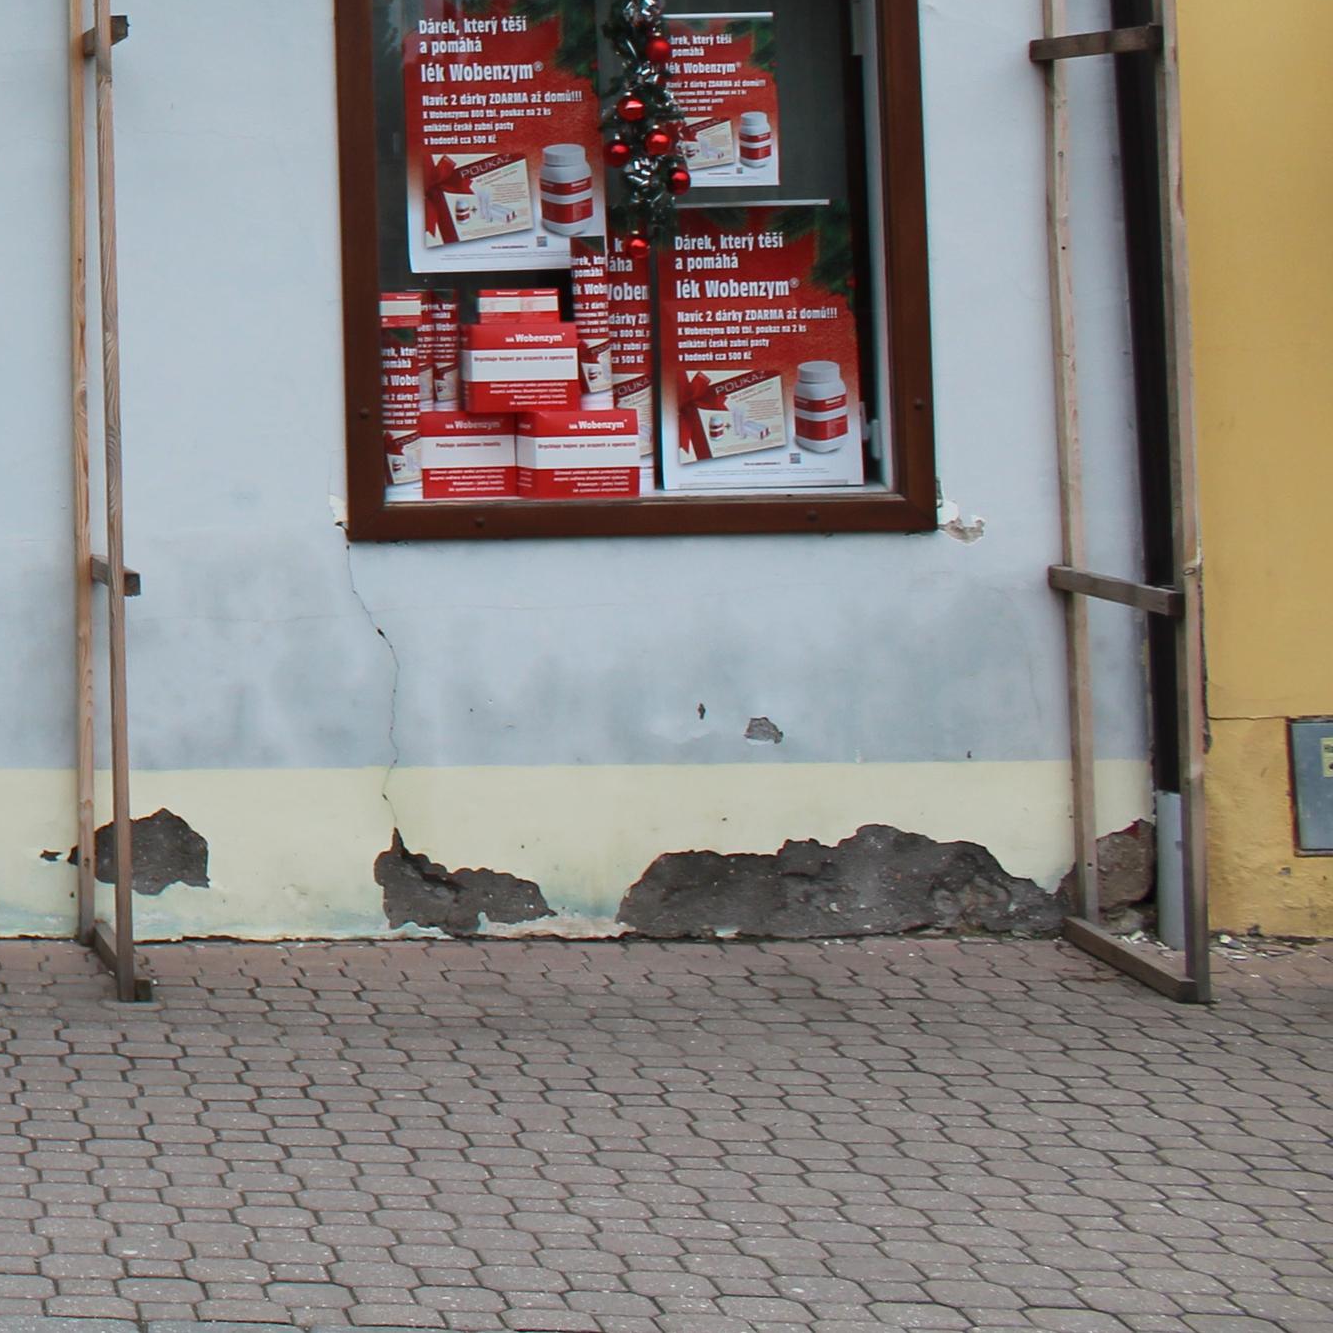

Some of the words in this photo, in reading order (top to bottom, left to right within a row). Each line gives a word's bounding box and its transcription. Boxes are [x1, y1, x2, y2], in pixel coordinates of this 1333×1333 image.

[419, 18, 459, 35] Dárek,
[464, 17, 498, 35] který
[501, 16, 527, 32] těší
[419, 42, 427, 54] a
[432, 37, 482, 56] pomáhá
[670, 35, 690, 45] árek,
[693, 35, 714, 46] který
[421, 62, 445, 82] lék
[422, 94, 448, 106] Navíc
[451, 95, 457, 105] 2
[460, 93, 486, 106] dárky
[489, 92, 528, 103] ZDARMA
[531, 92, 541, 102] až
[460, 155, 512, 178] POUKAZ
[675, 234, 715, 251] Dárek,
[720, 233, 754, 251] který
[758, 232, 783, 248] těší
[675, 258, 683, 270] a
[687, 253, 738, 272] pomáhá
[677, 279, 700, 298] lék
[677, 310, 703, 322] Navíc
[706, 311, 713, 322] 2
[716, 310, 742, 323] dárky
[745, 309, 784, 320] ZDARMA
[787, 308, 797, 319] až
[715, 371, 766, 395] POUKAZ
